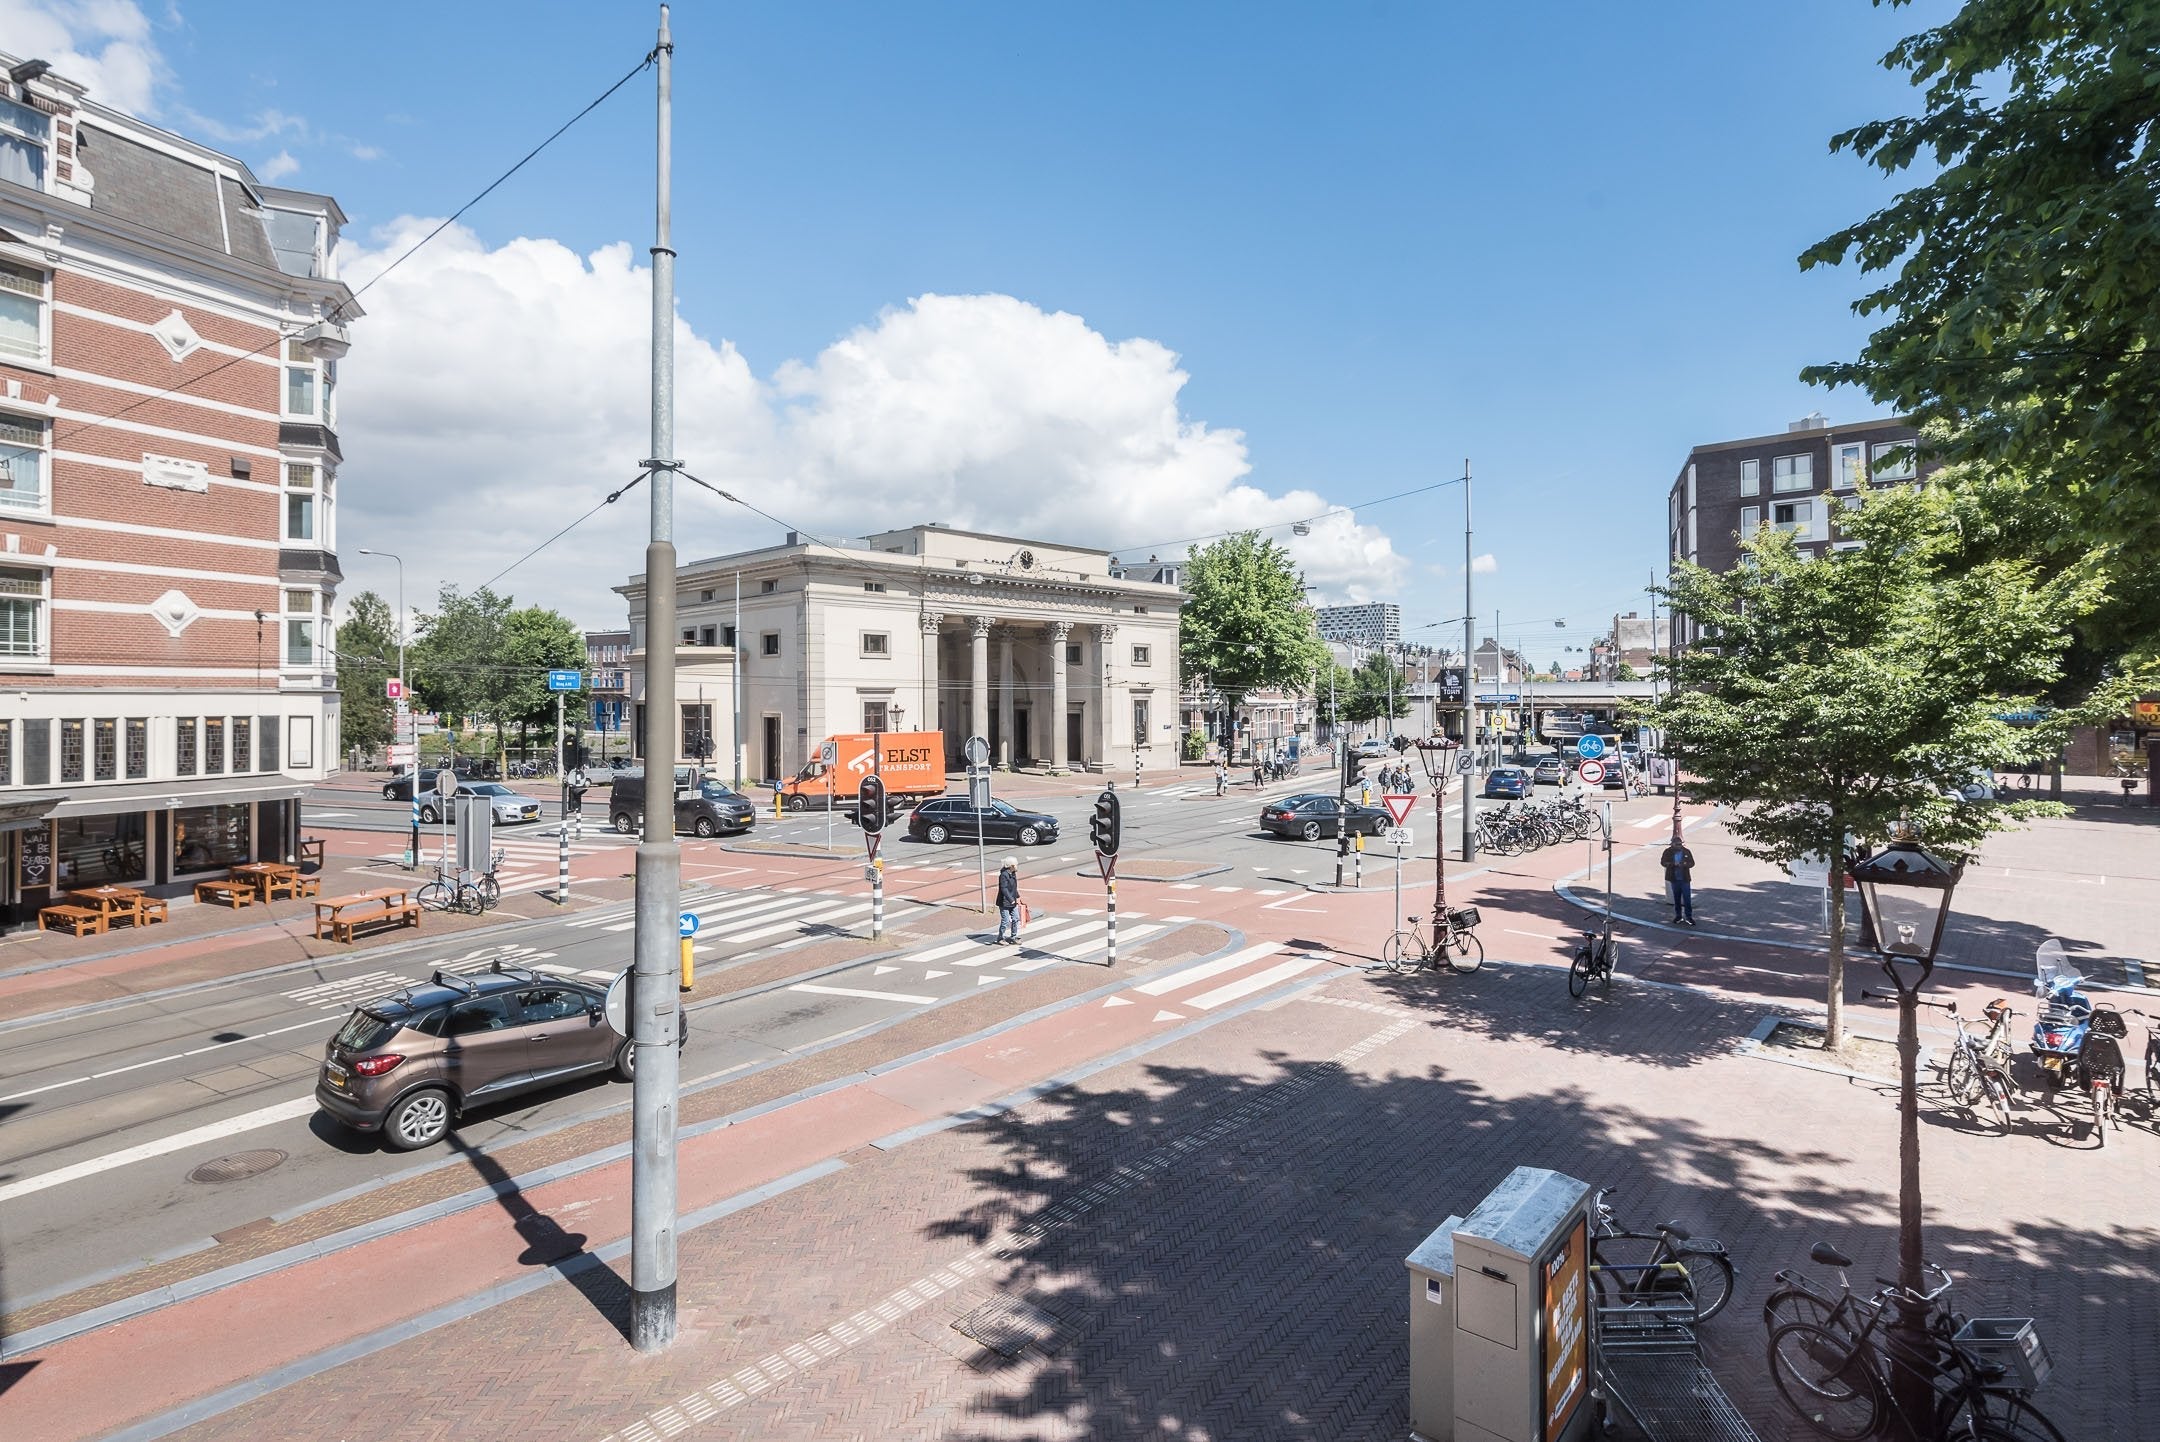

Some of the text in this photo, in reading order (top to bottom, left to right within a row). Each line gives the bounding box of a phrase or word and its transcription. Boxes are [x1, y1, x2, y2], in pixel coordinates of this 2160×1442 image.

[887, 748, 931, 762] ELST
[879, 764, 932, 772] TRANSPORT
[24, 832, 49, 843] WAIT
[37, 843, 50, 853] BE
[22, 855, 52, 867] SEATED
[1551, 1250, 1565, 1277] 100%
